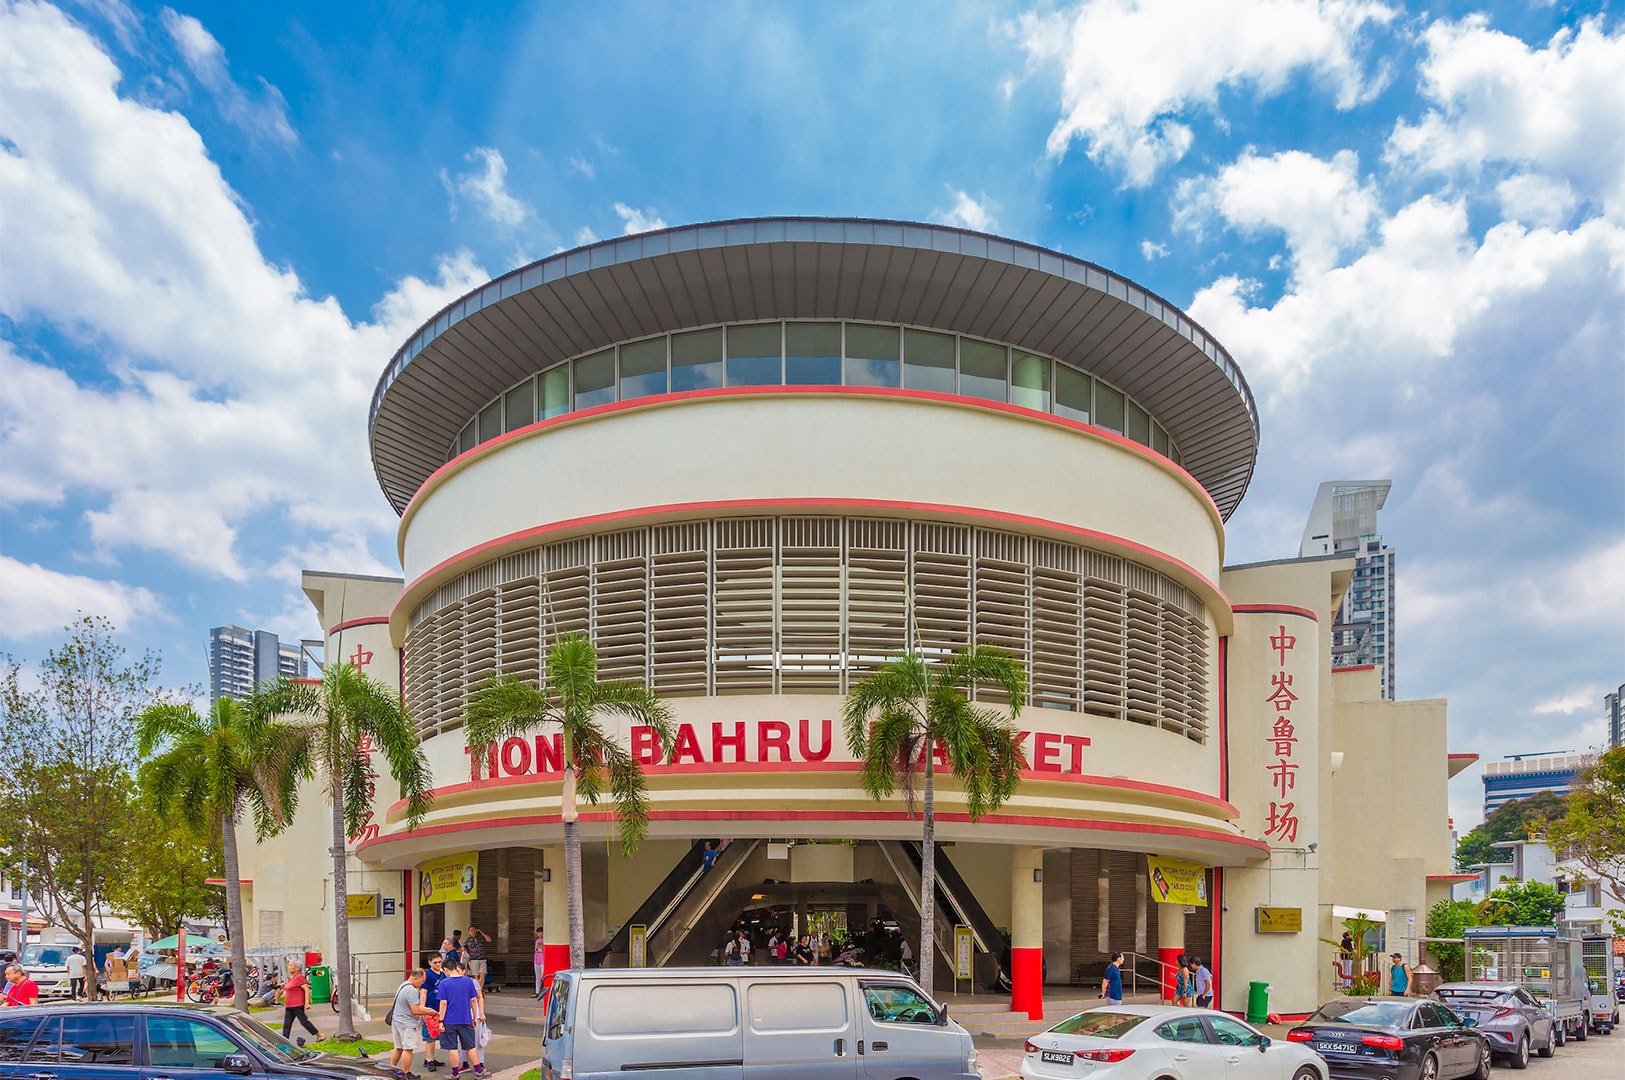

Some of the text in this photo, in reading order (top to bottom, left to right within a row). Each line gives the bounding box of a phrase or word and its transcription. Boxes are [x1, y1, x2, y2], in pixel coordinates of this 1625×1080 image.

[464, 719, 1091, 781] TION BAHRU AKET
[1264, 625, 1300, 843] 中峇鲁市场
[1319, 1042, 1355, 1052] SKK5471C
